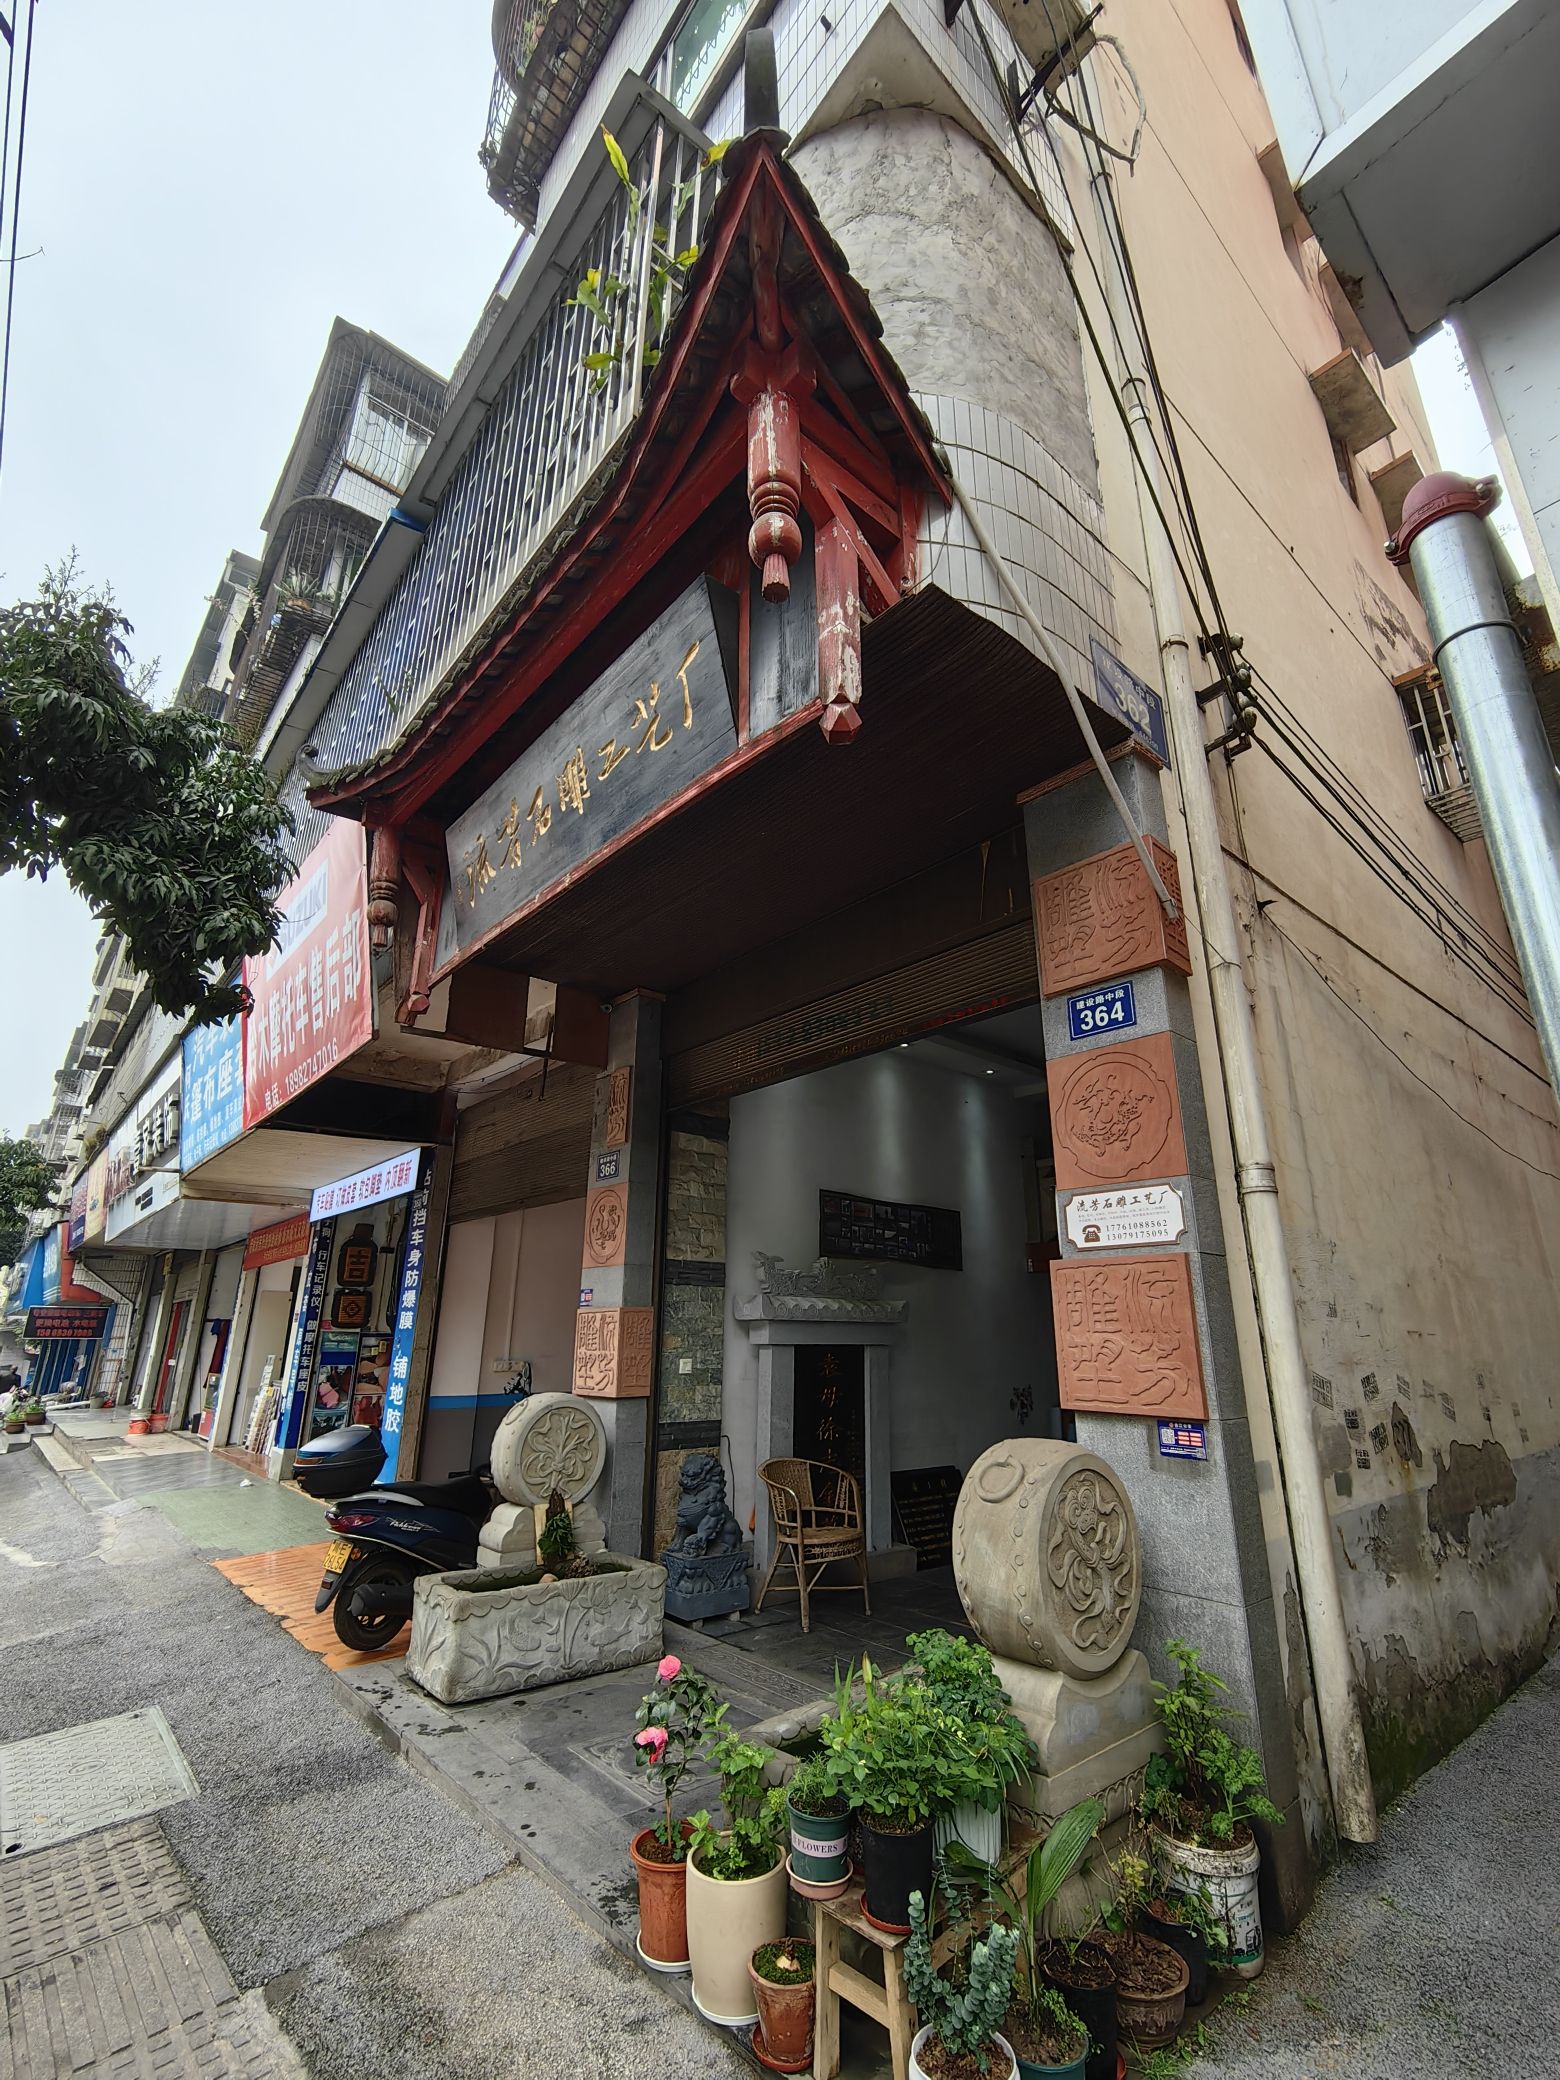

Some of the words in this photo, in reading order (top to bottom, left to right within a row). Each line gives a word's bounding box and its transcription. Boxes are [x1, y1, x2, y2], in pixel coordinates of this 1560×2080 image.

[1115, 682, 1152, 738] 362
[1076, 989, 1125, 1010] 建设路中段
[1080, 1001, 1125, 1030] 364
[600, 1162, 616, 1176] 366
[1076, 1190, 1168, 1212] 流芳石雕工艺厂
[1106, 1220, 1168, 1231] 17761088562
[1107, 1229, 1169, 1240] 13079175095
